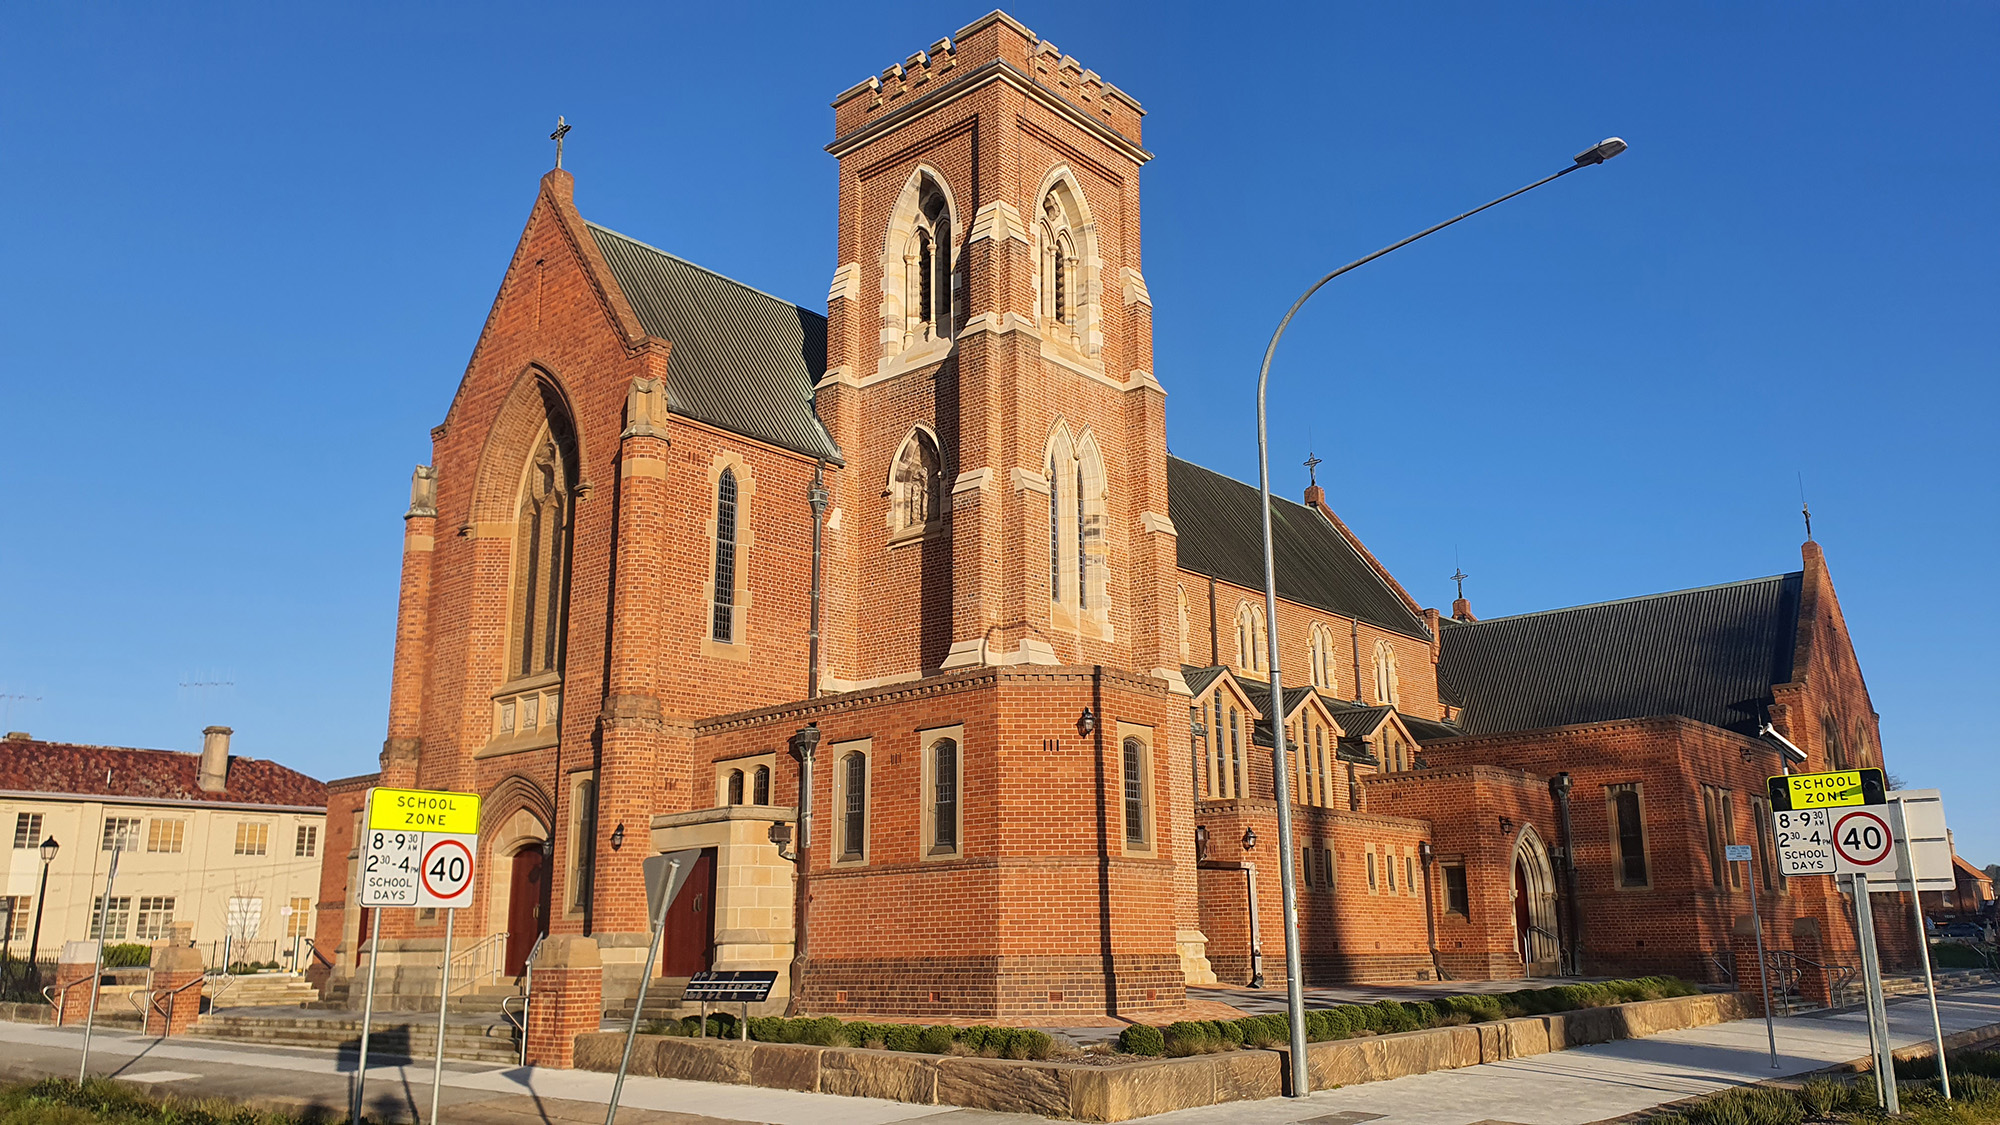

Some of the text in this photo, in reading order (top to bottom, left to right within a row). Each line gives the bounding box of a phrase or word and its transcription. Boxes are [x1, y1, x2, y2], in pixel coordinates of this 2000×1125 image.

[1794, 777, 1856, 790] SCHOOL
[398, 796, 456, 810] SCHOOL
[1806, 791, 1848, 803] ZONE
[405, 813, 446, 825] ZONE
[1843, 826, 1881, 850] 40
[1785, 850, 1828, 859] SCHOOL
[429, 857, 464, 882] 40
[1792, 861, 1824, 869] DAYS
[369, 878, 412, 887] SCHOOL
[374, 891, 405, 900] DAYS
